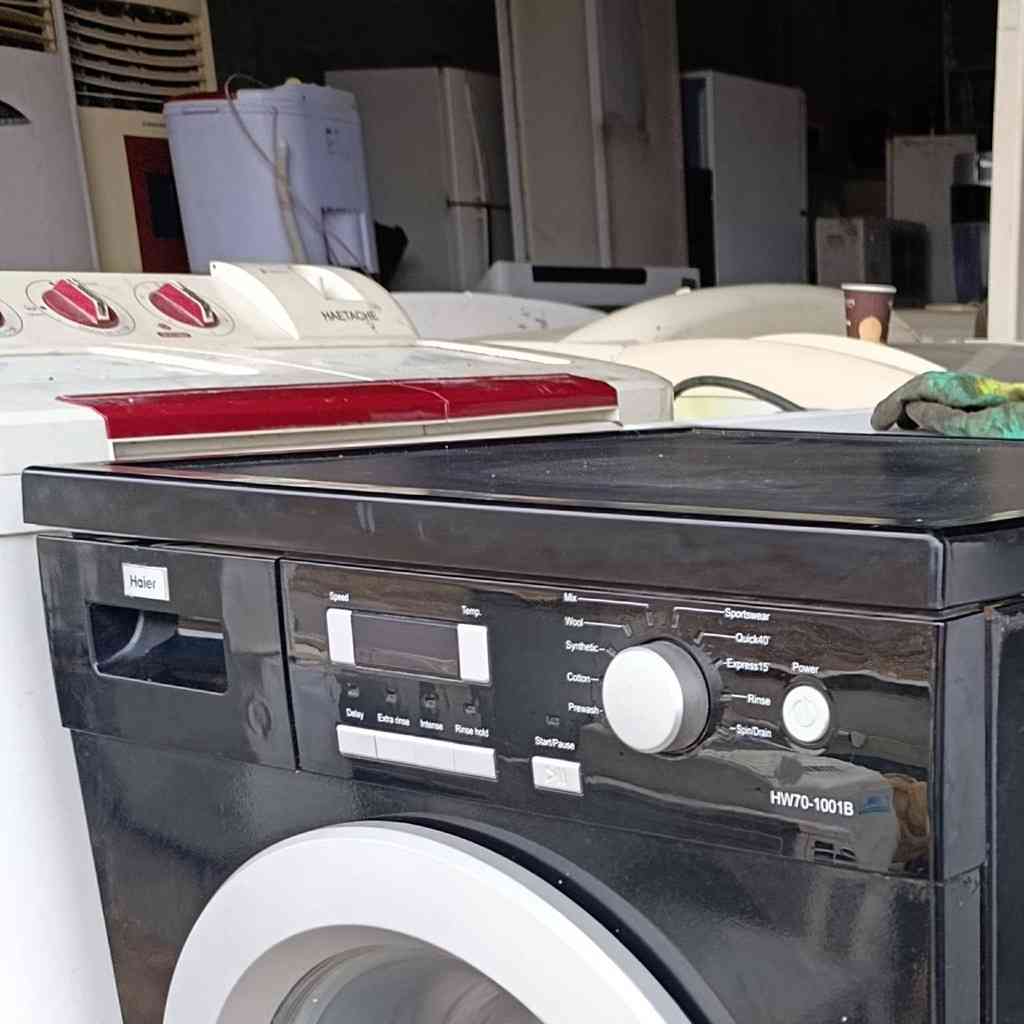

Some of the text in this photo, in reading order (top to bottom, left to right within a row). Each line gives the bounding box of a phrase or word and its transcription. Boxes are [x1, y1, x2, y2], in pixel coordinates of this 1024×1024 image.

[129, 574, 156, 590] Haier
[329, 591, 350, 603] Speed
[564, 593, 578, 603] Mix
[724, 608, 770, 622] Sportswear
[564, 616, 584, 628] Wool
[565, 640, 599, 653] Synthetic
[791, 661, 819, 674] Power
[567, 672, 591, 684] Cotton
[747, 693, 771, 706] Rinse
[346, 708, 364, 721] Delay
[568, 702, 600, 715] Prewash
[377, 713, 410, 727] Extra rinse
[419, 719, 444, 731] Intense
[455, 725, 490, 738] Rinse hold
[736, 723, 772, 738] Spin/Drain
[535, 736, 575, 751] Start/Pause
[770, 790, 854, 816] HW70-1001B
